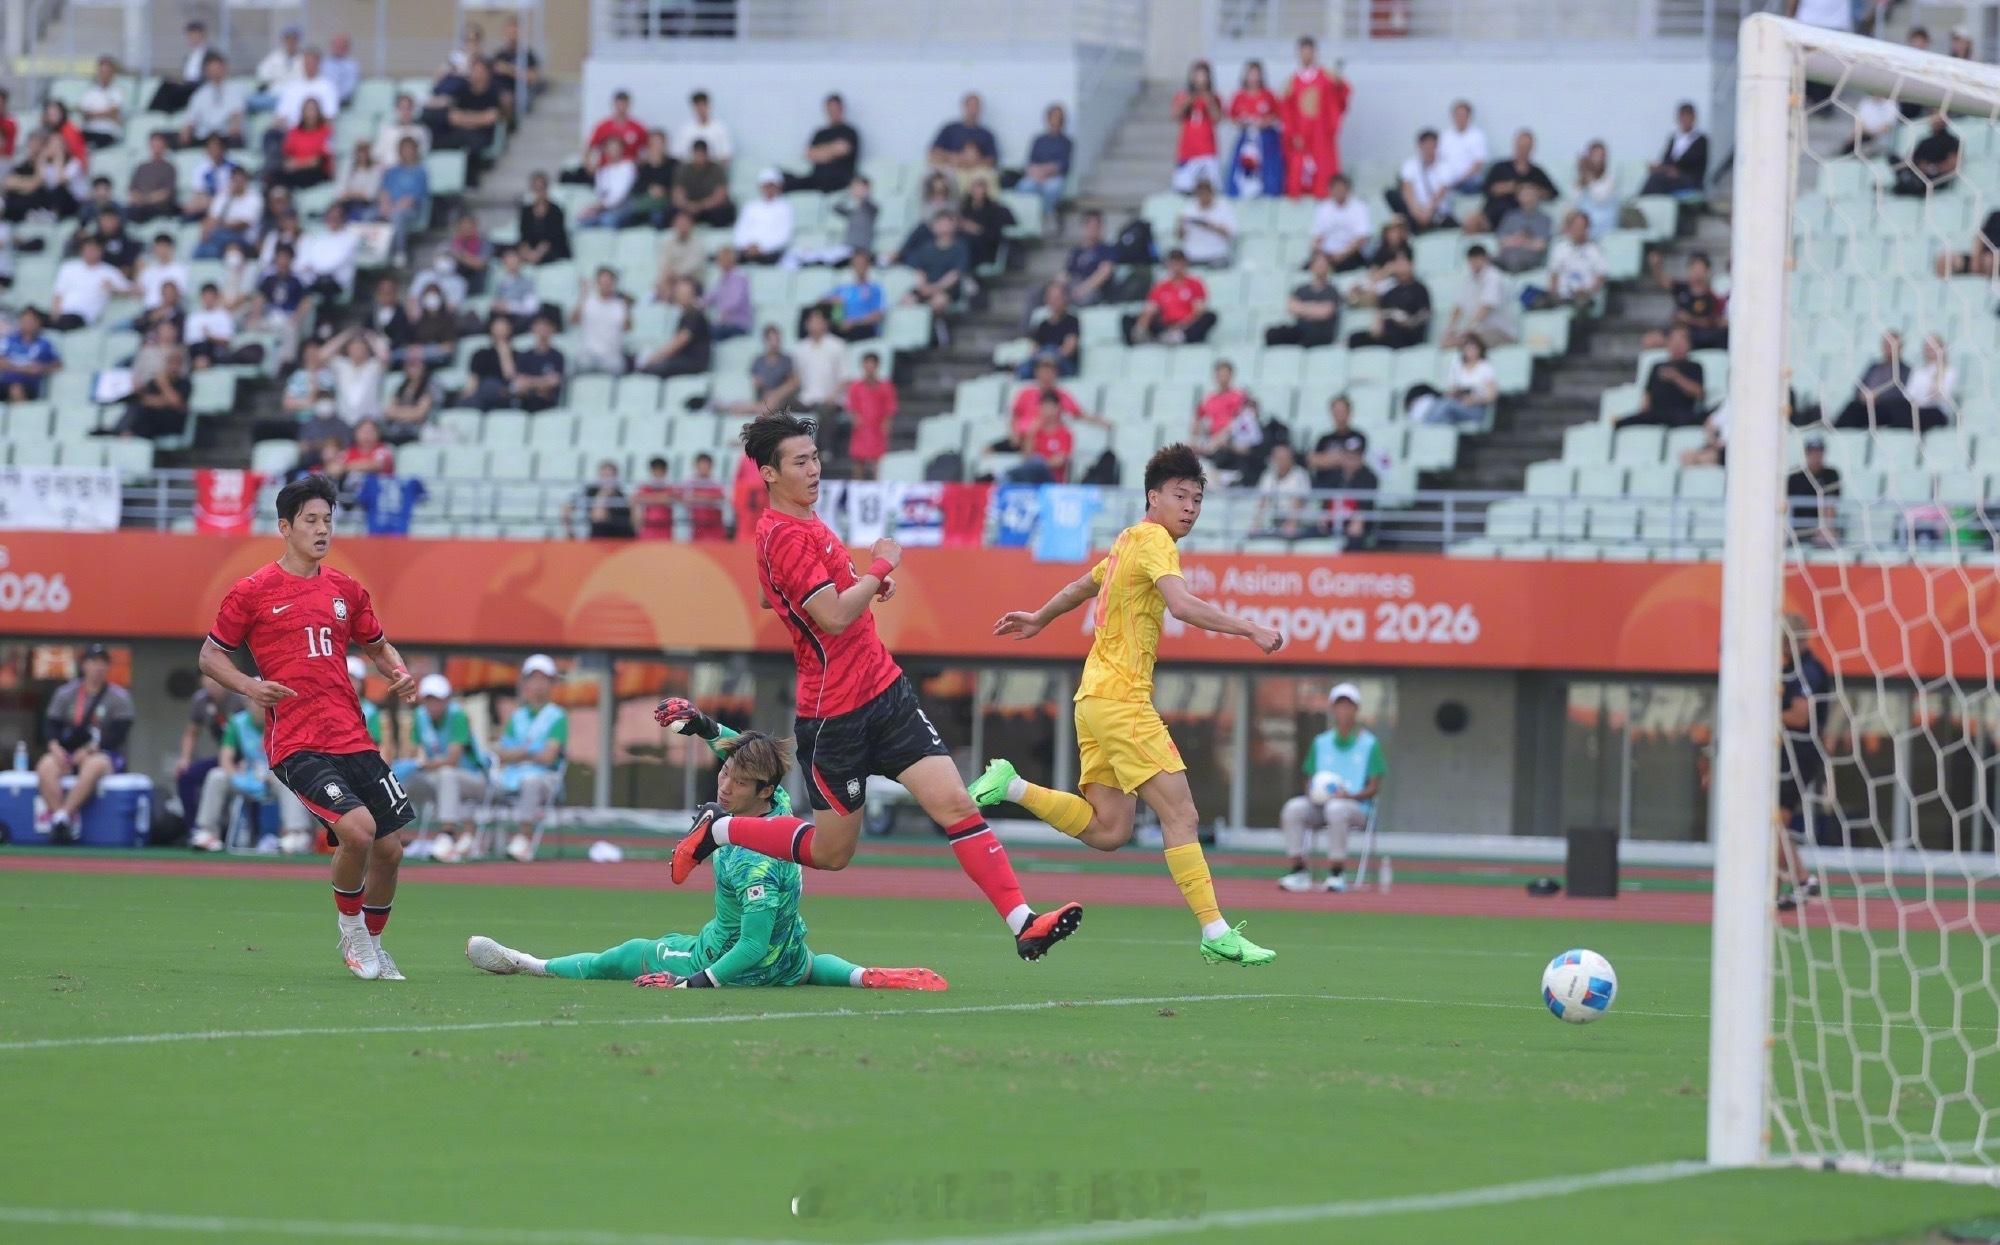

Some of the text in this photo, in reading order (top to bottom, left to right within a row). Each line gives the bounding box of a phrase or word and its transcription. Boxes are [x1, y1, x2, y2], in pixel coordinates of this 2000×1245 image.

[1220, 563, 1303, 597] Asian
[1308, 567, 1415, 598] Games
[1374, 601, 1480, 644] 2026
[304, 626, 333, 658] 16
[379, 771, 407, 808] 16
